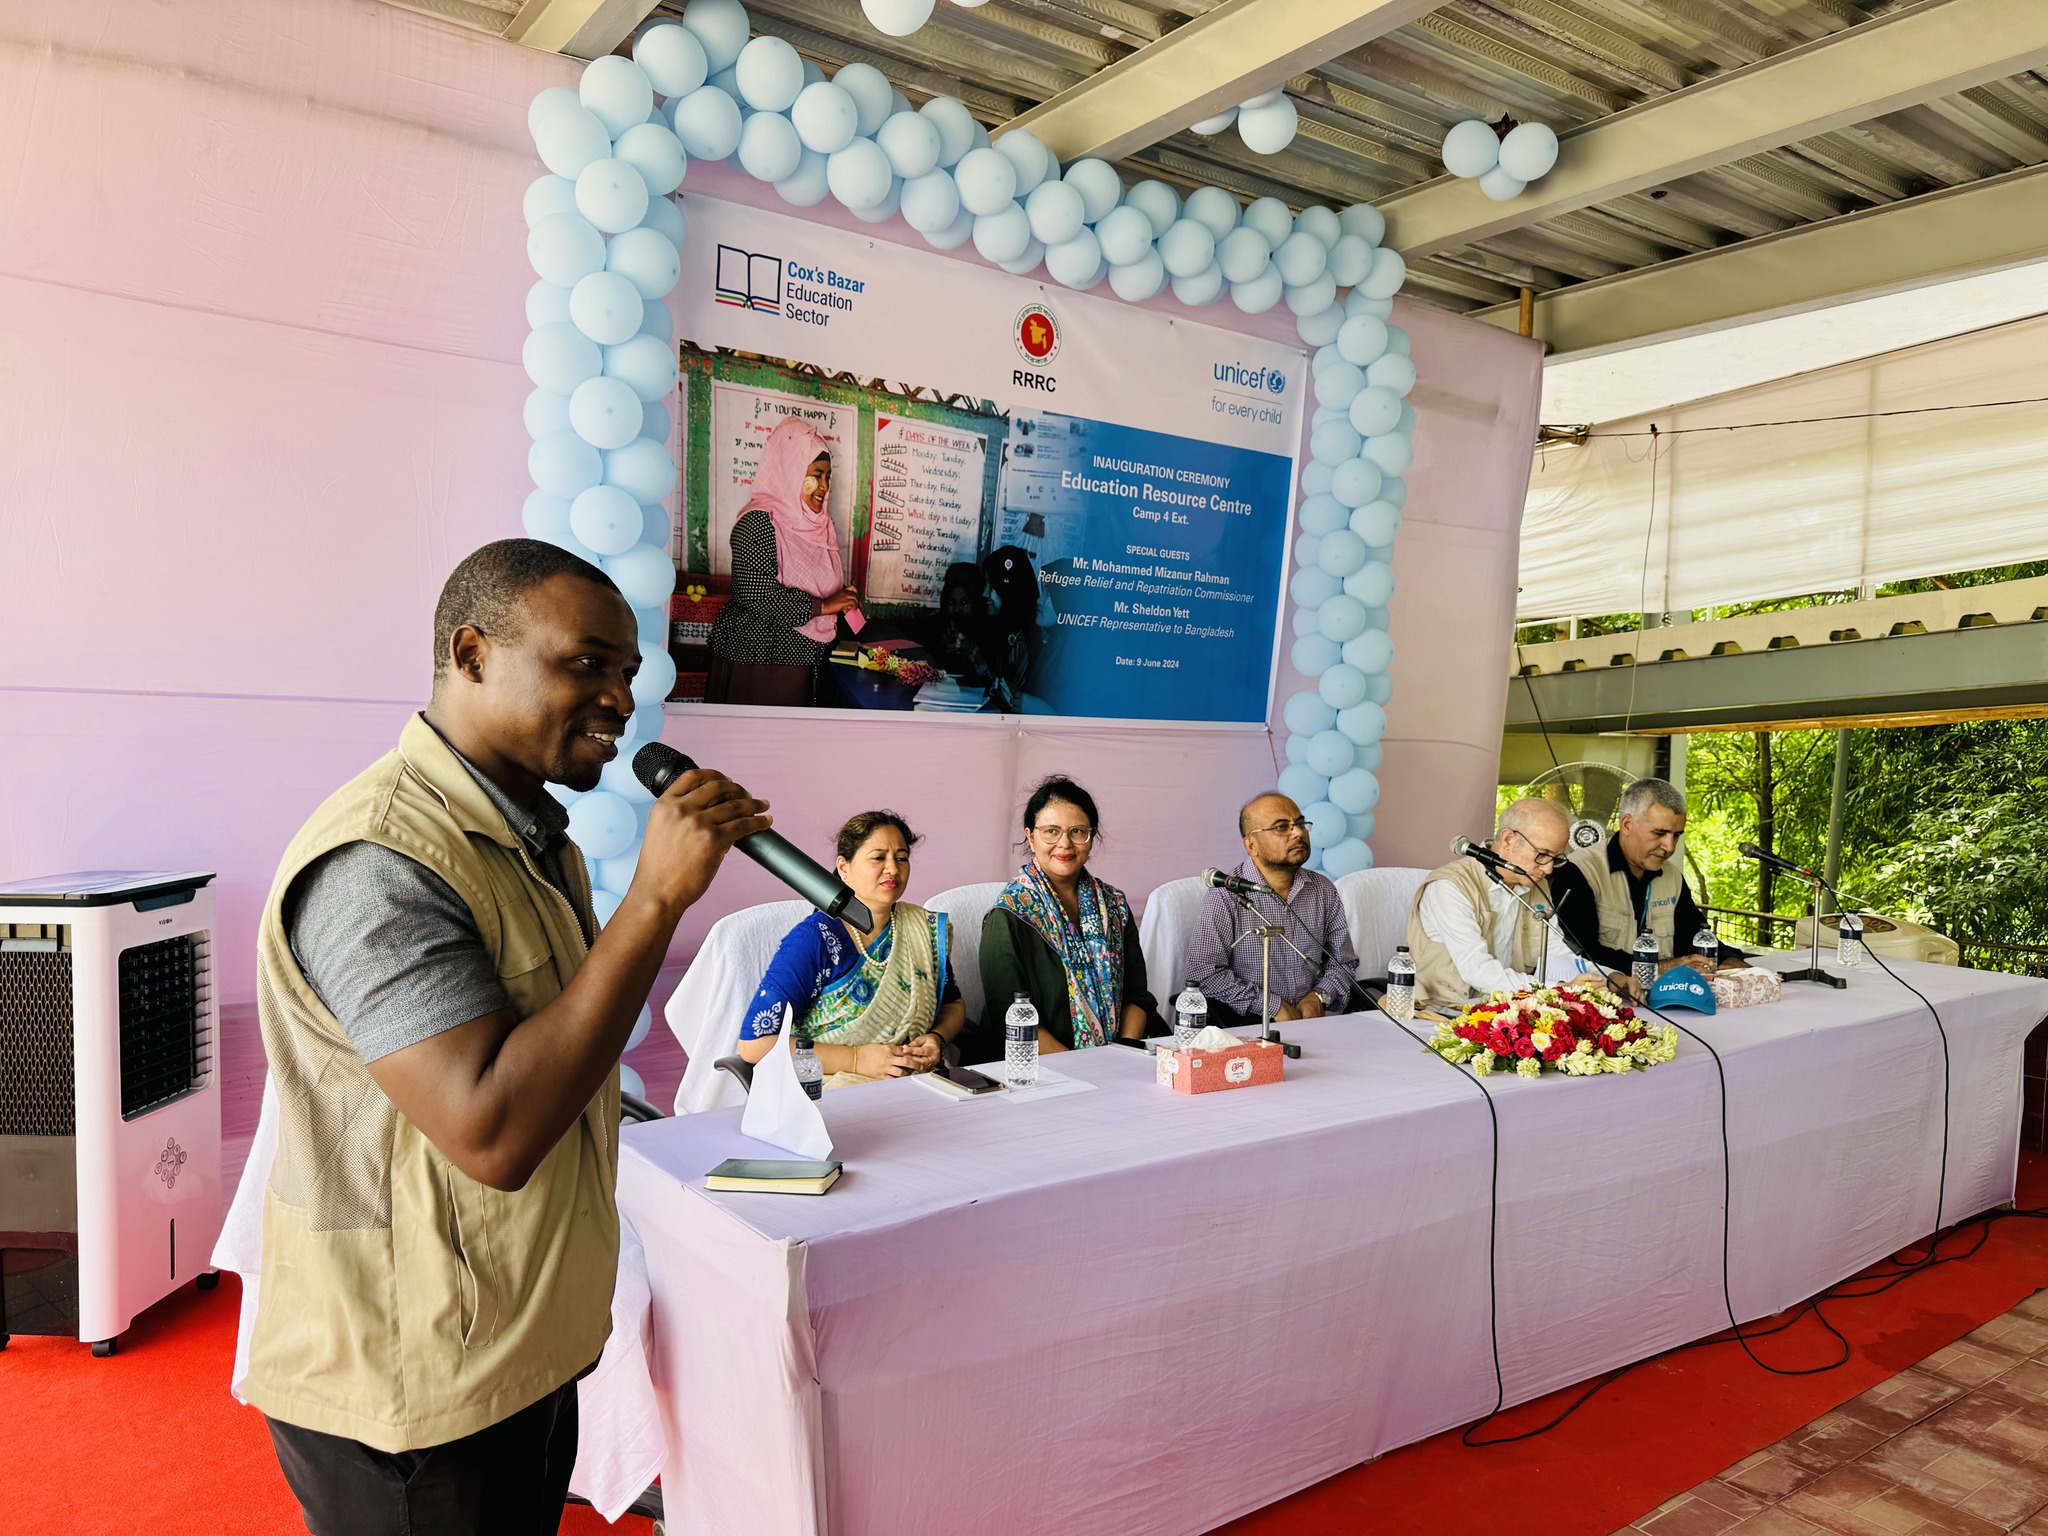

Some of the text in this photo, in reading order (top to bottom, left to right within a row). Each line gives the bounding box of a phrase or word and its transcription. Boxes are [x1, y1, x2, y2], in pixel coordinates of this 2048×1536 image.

[788, 261, 865, 293] Cox's Bazar
[786, 282, 853, 311] Education
[786, 303, 829, 326] Sector
[1013, 370, 1056, 392] RRRC
[1213, 361, 1266, 389] unicef
[764, 402, 828, 421] IF YOU'RE HAPPY
[1211, 396, 1282, 425] for every child
[905, 430, 925, 440] DAYS
[938, 436, 949, 446] THE
[952, 438, 970, 449] WEEK
[1093, 455, 1230, 489] INAUGURATION CEREMONY
[1061, 470, 1138, 499] Education
[1142, 483, 1206, 509] Resource
[1210, 494, 1252, 515] Centre
[907, 508, 926, 520] What
[928, 512, 940, 525] day
[955, 516, 977, 529] today?
[1132, 506, 1189, 525] Camp 4 Ext.
[1126, 544, 1190, 561] SPECIAL GUESTS
[1072, 556, 1230, 585] Mr. Mohammed Mizanur Rahman
[923, 586, 935, 597] day
[1037, 570, 1255, 603] Refugee Relief and Repatriation Commissioner
[1113, 601, 1190, 619] Mr. Sheldon Yett
[1057, 613, 1235, 639] UNICEF Representative to Bangladesh
[1115, 656, 1179, 668] Date: 9 June 2024
[1651, 897, 1671, 908] unicef
[1659, 982, 1689, 992] unicef
